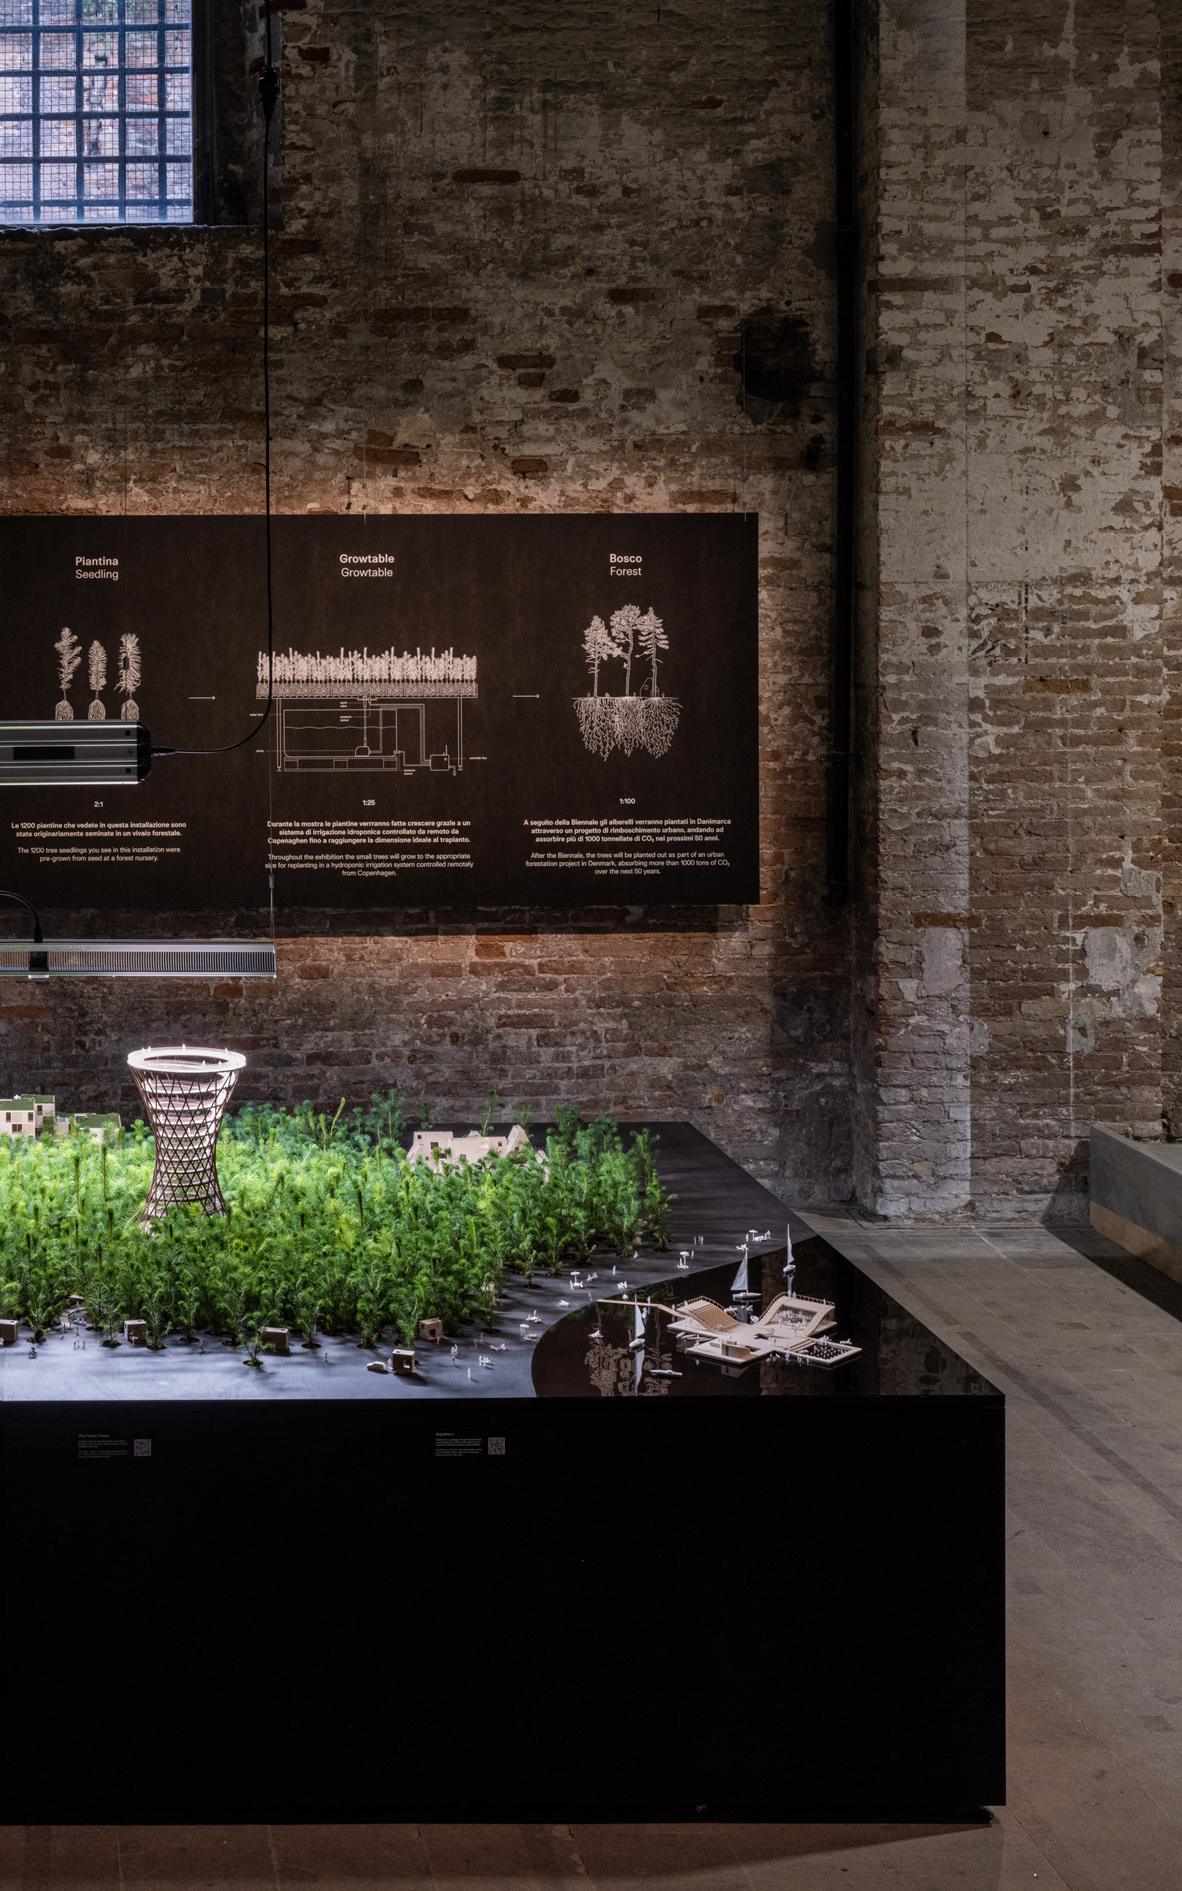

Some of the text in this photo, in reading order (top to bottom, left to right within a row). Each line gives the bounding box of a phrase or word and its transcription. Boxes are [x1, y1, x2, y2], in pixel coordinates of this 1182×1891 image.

[76, 557, 119, 566] Piantina
[339, 554, 395, 564] Growtable
[610, 553, 642, 563] Bosco
[76, 570, 119, 581] Seedling
[341, 568, 393, 577] Growtable
[610, 566, 642, 576] Forest
